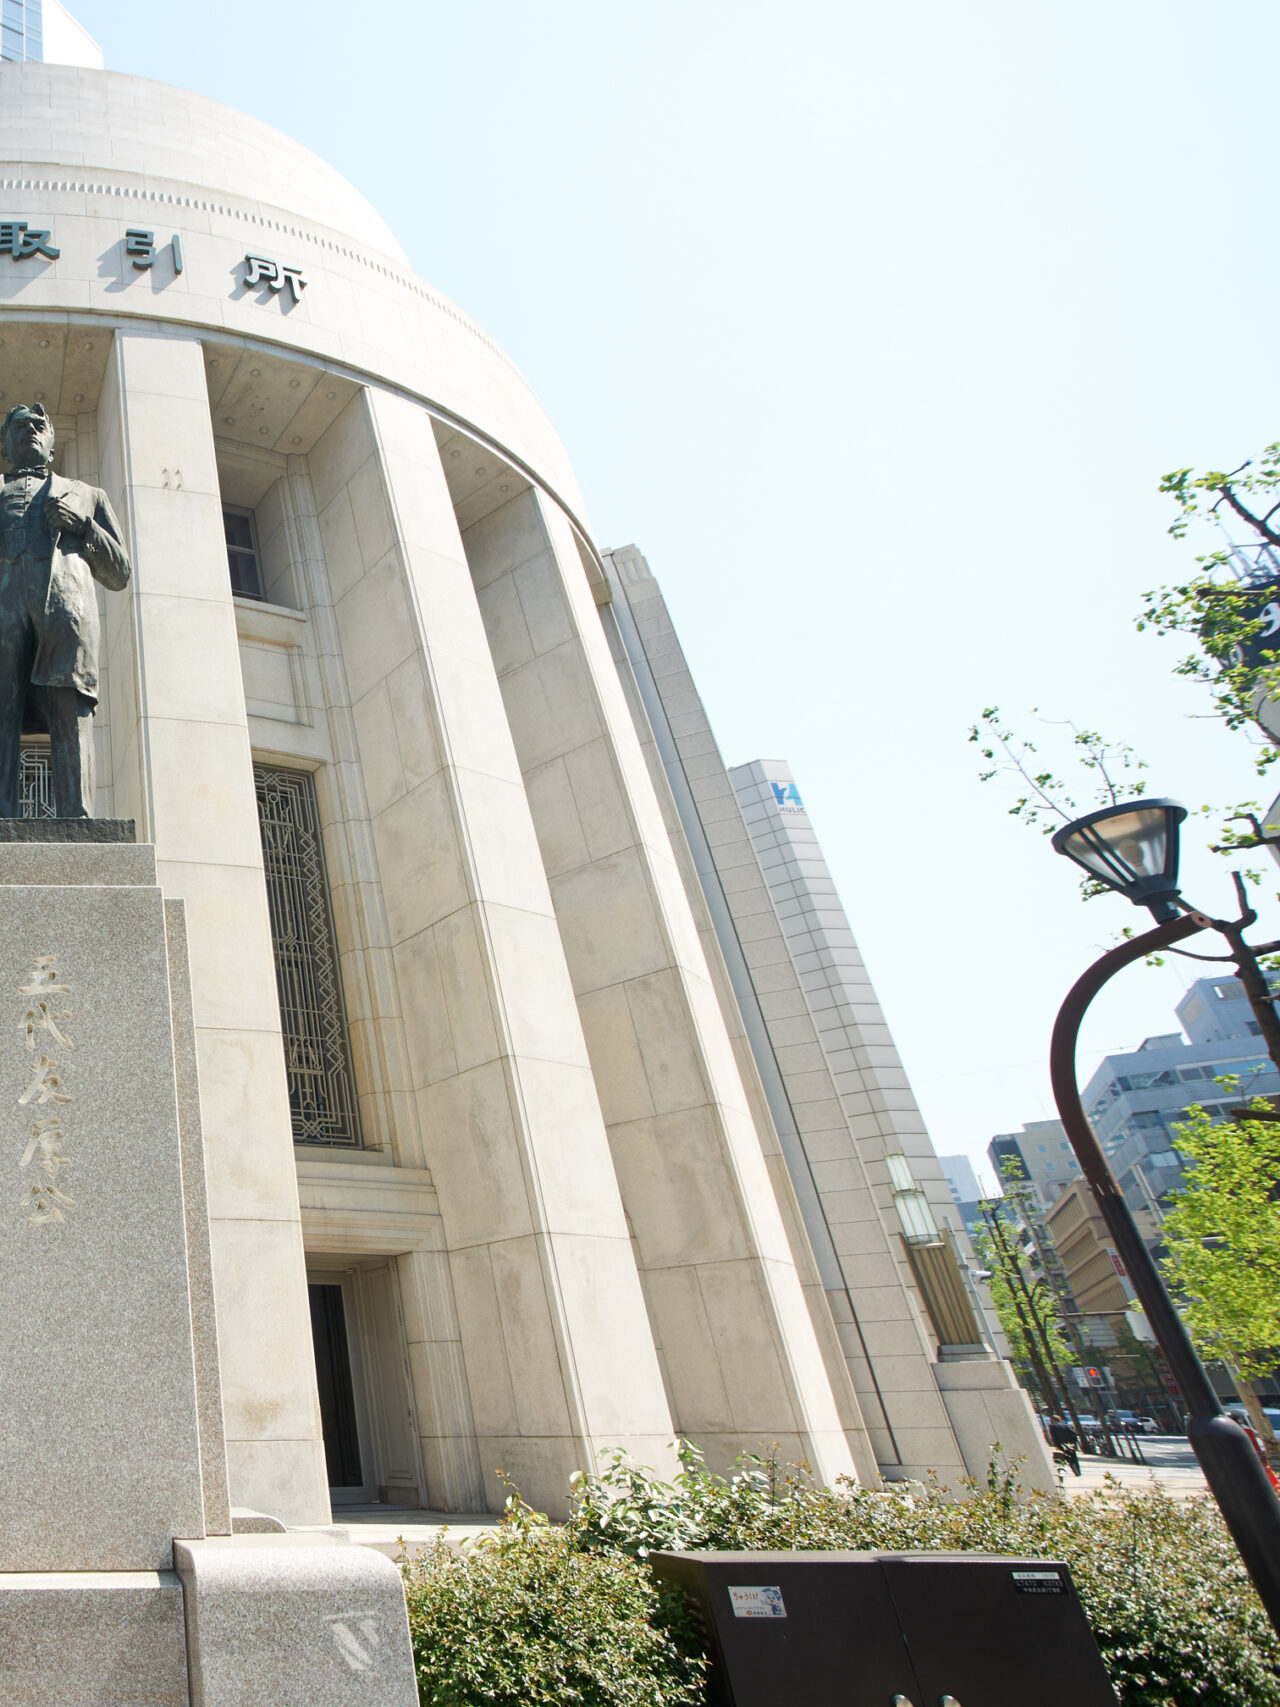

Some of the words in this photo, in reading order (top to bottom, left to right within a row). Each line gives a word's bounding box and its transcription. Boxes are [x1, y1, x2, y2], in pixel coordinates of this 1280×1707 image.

[18, 955, 77, 1226] 五代友厚公
